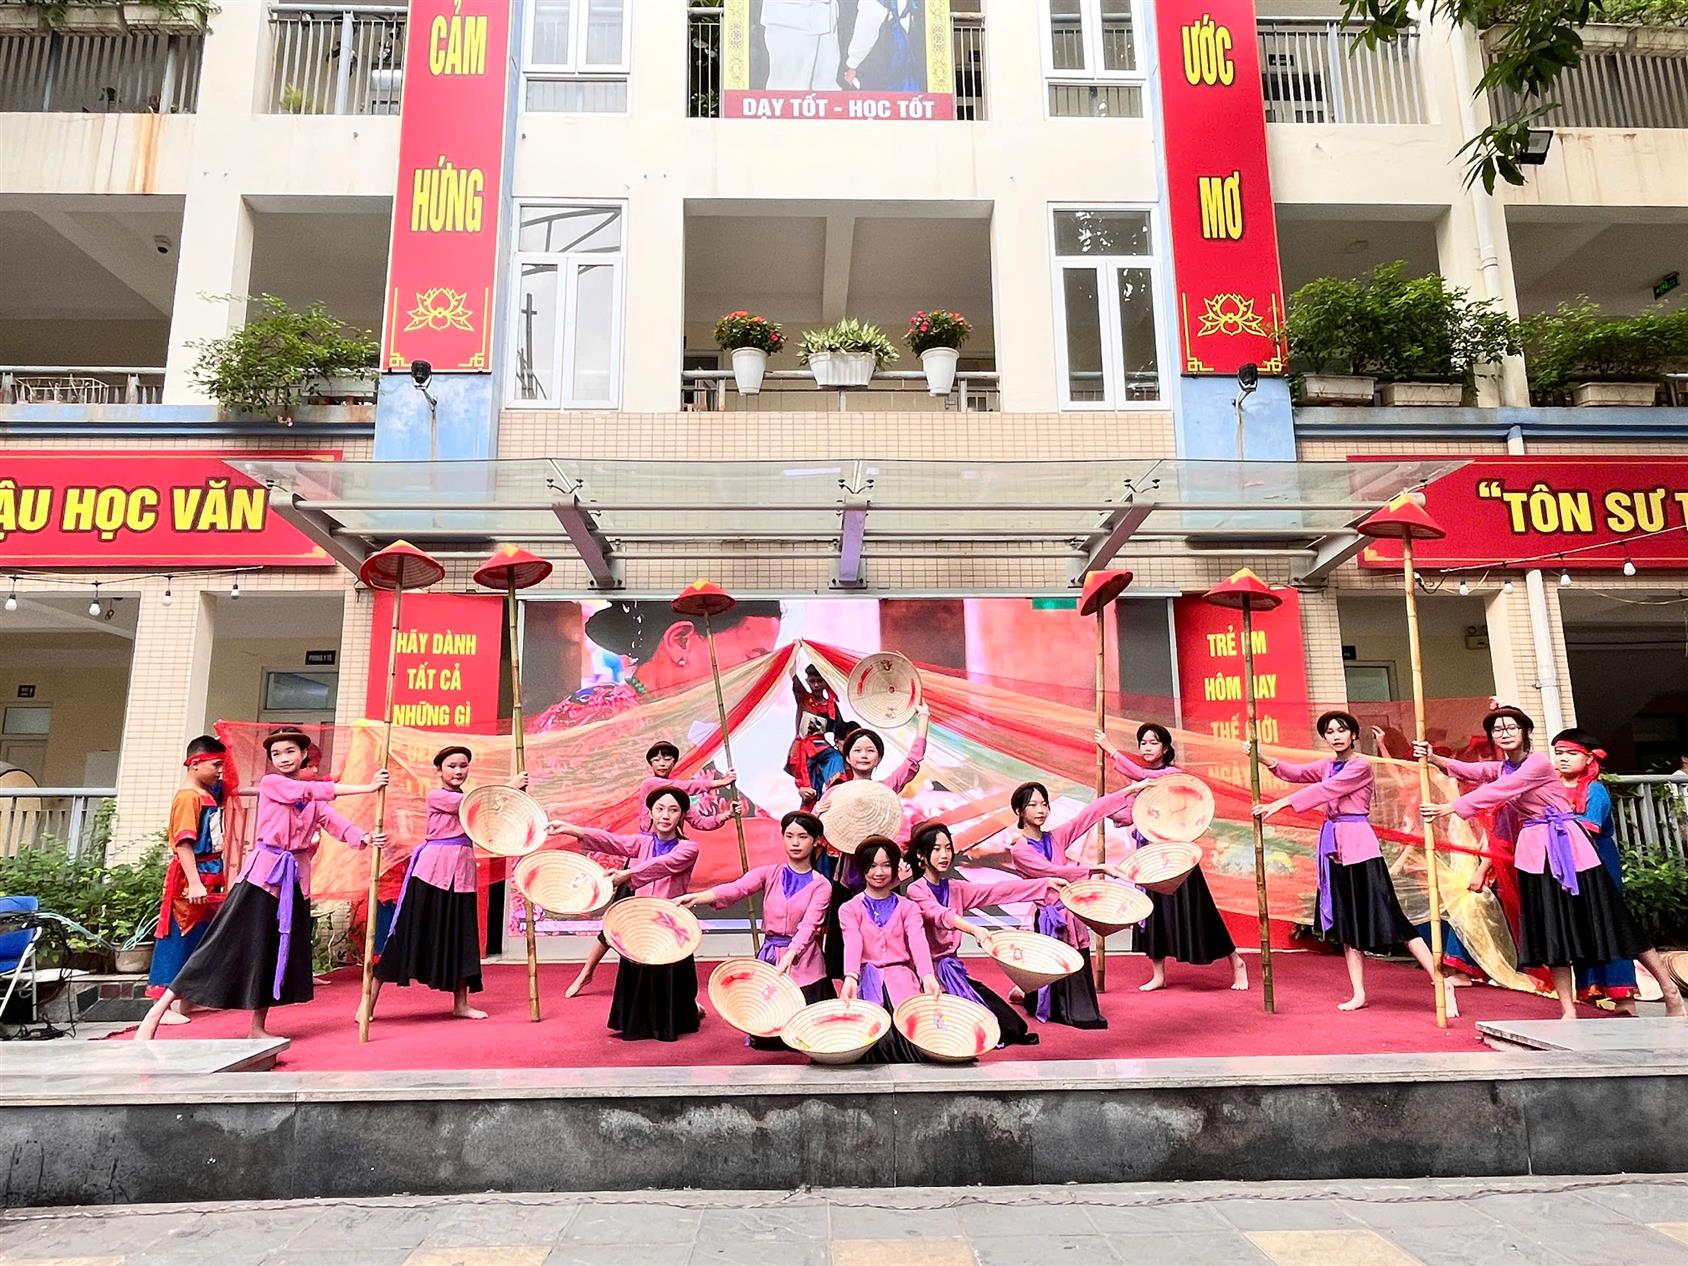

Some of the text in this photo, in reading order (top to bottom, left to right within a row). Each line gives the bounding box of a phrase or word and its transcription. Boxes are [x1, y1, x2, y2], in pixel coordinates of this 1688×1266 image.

[429, 0, 488, 76] CẢM
[1181, 13, 1235, 86] ƯỚC
[742, 98, 786, 120] DẠY
[790, 93, 829, 118] TỐT
[848, 99, 892, 120] HỌC
[897, 94, 935, 119] TỐT
[410, 155, 485, 233] HỨNG
[1198, 171, 1243, 241] MƠ
[62, 487, 159, 541] HỌC
[172, 479, 266, 532] VĂN
[1604, 488, 1667, 533] SƯ
[396, 628, 477, 656] HÃY DÀNH
[1207, 625, 1238, 657] TRẺ
[407, 661, 462, 691] TẤT CẢ
[1204, 671, 1242, 701] HÔM
[393, 700, 472, 727] NHỮNG GÌ
[1211, 713, 1241, 741] THẾ
